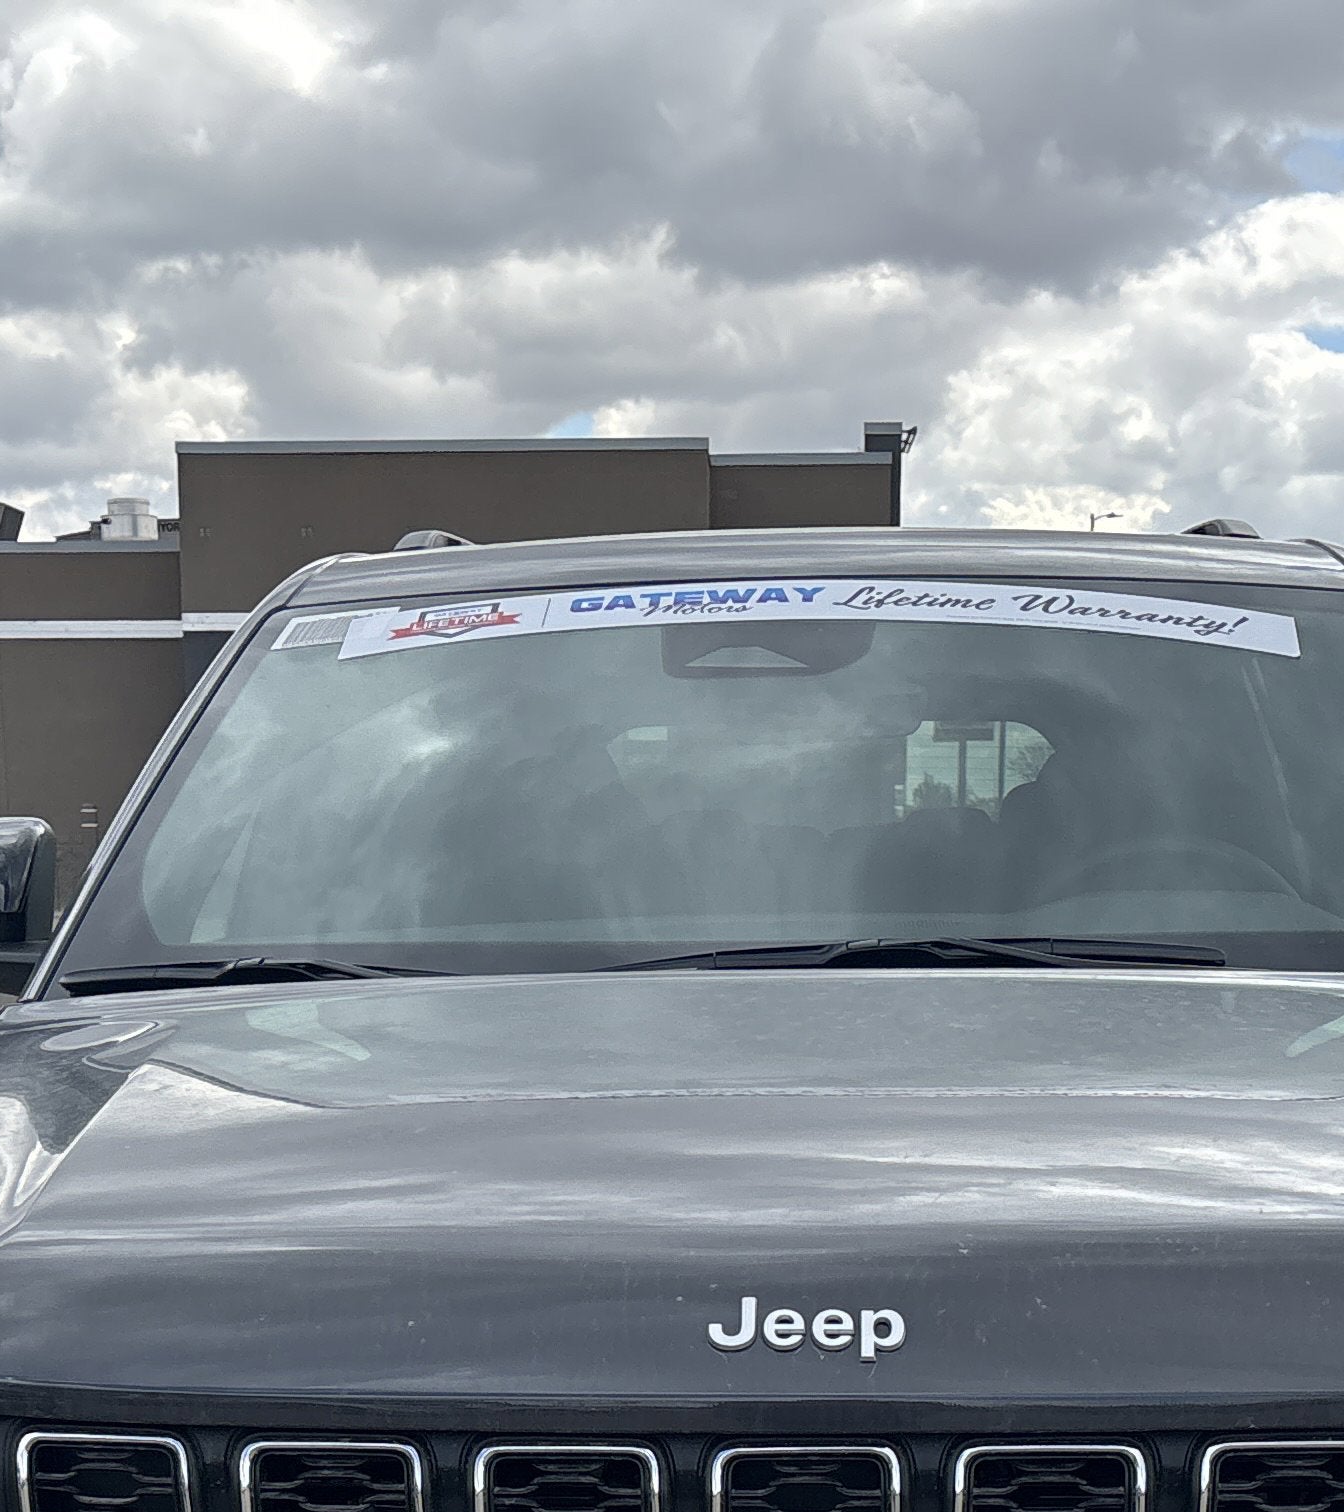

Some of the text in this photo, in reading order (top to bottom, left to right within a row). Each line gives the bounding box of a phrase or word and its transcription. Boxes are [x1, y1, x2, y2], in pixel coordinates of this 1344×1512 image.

[411, 612, 499, 631] LIFETIME
[570, 586, 826, 613] GATEWAY
[832, 586, 997, 611] Lifetime
[1011, 594, 1250, 635] Warranty!
[640, 601, 754, 617] Motors
[707, 1296, 907, 1362] Jeep
